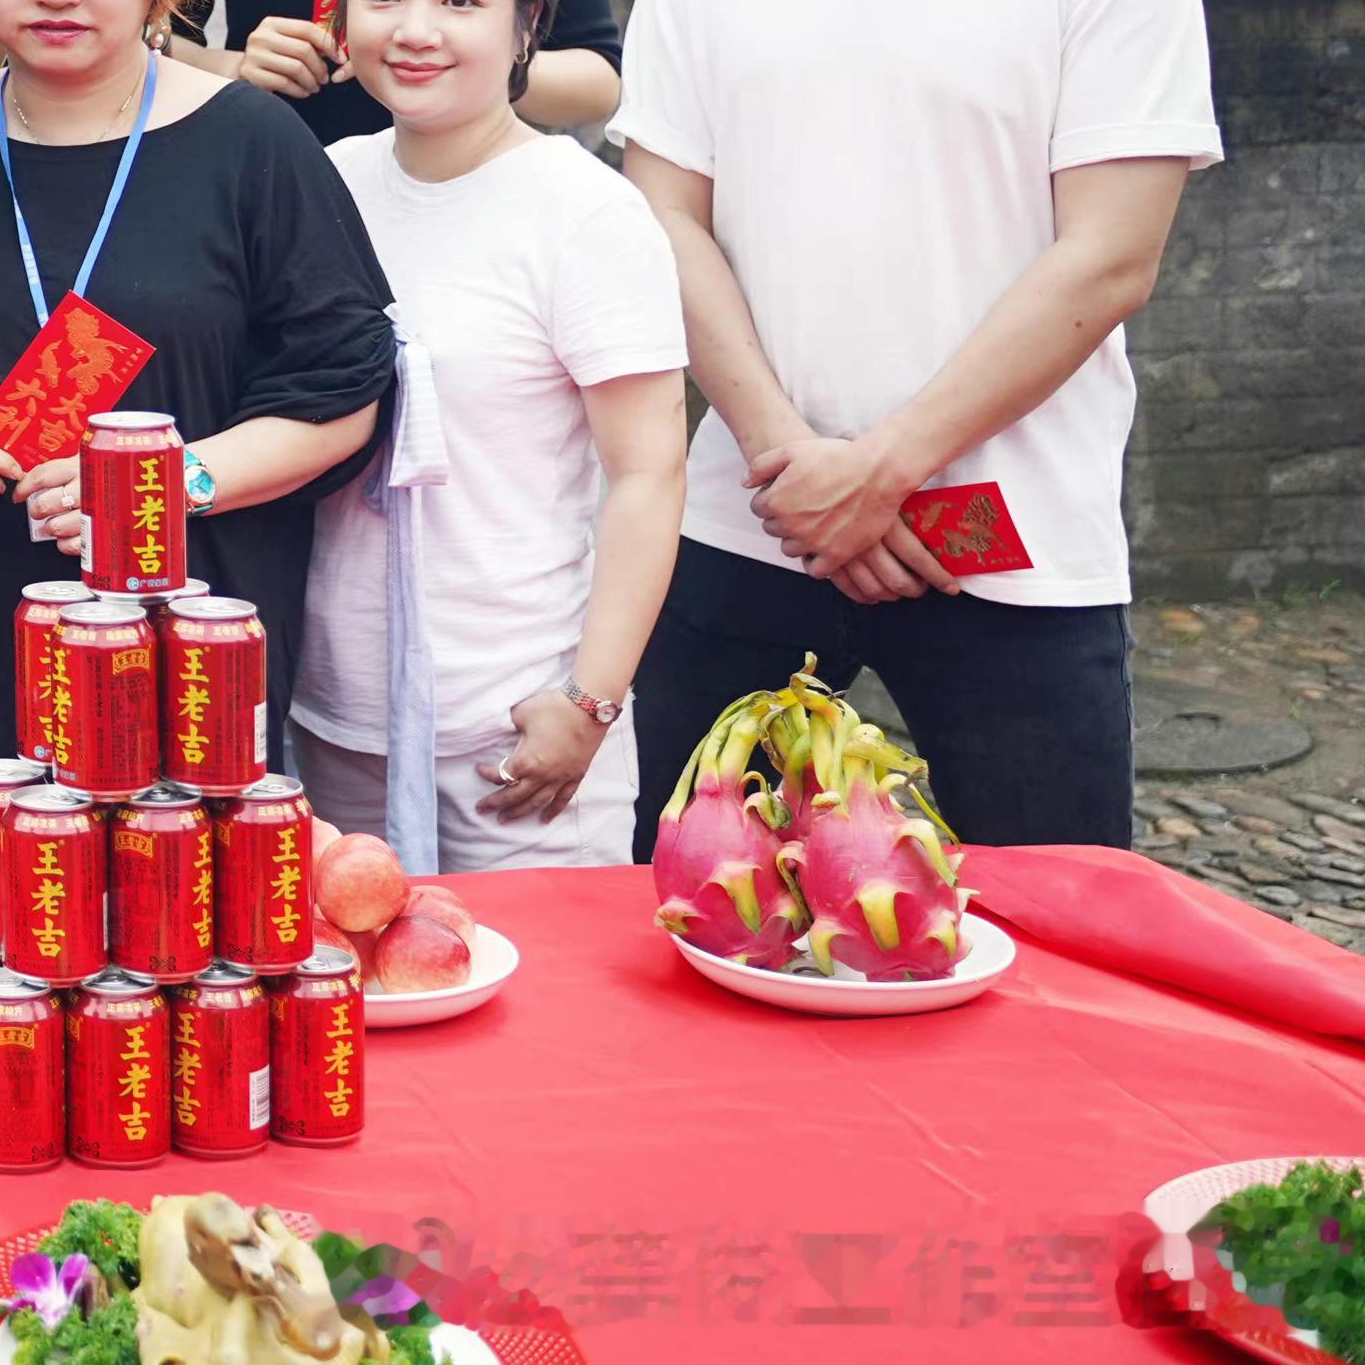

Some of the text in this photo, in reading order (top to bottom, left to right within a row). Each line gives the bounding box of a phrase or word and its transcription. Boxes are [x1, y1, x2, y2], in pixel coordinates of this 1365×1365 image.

[38, 391, 87, 453] 大吉
[132, 457, 166, 575] 王老吉
[52, 648, 72, 765] 王老吉
[177, 647, 211, 764] 王老吉
[30, 841, 66, 958] 王老吉
[192, 831, 213, 948] 王老吉
[270, 827, 302, 944] 王老吉
[118, 1025, 151, 1141] 王老吉
[173, 1012, 202, 1127] 王老吉
[324, 1003, 354, 1117] 王老吉
